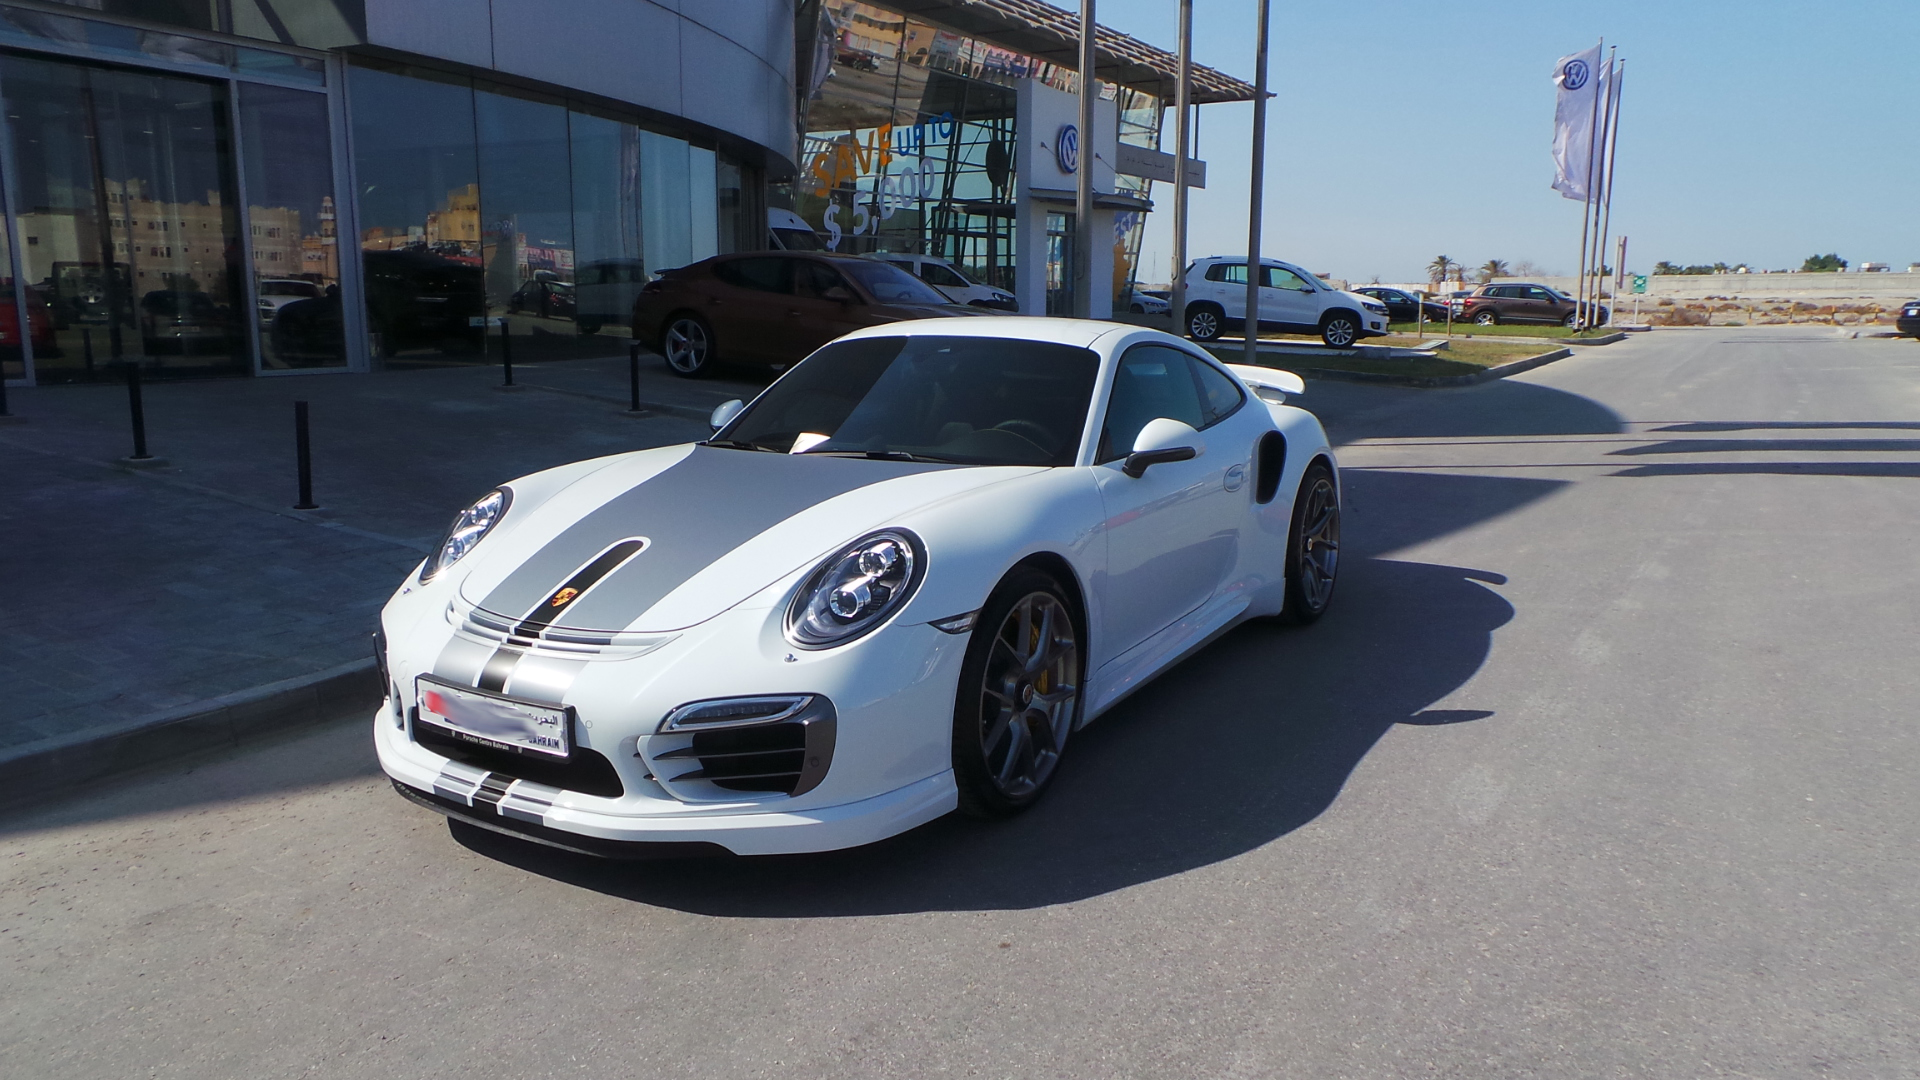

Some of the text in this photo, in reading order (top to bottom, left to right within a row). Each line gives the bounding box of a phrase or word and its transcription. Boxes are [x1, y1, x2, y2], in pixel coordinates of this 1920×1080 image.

[813, 111, 954, 197] SAVE UP TO
